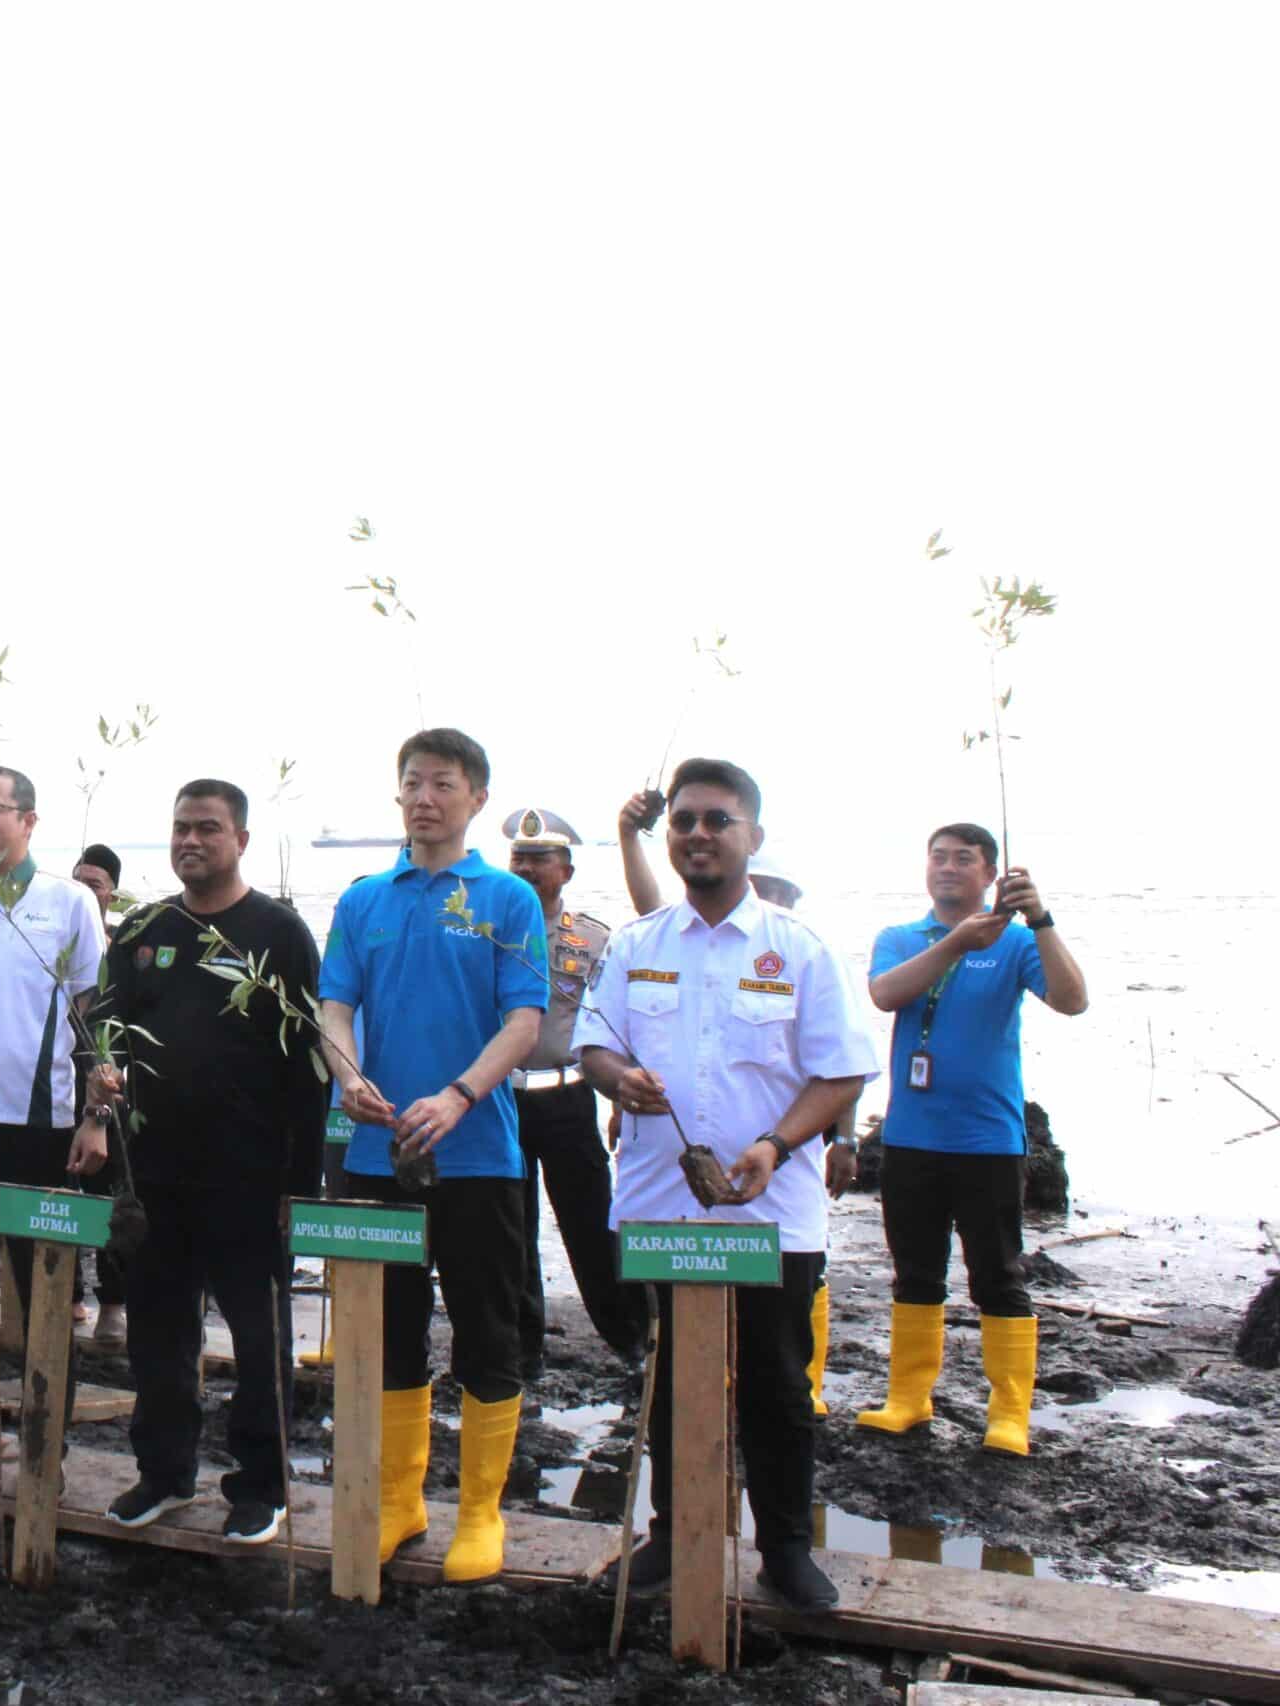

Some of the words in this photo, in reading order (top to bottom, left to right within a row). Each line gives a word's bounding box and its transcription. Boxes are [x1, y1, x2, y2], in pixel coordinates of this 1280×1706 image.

[40, 1200, 70, 1217] DLH
[29, 1215, 79, 1235] DUMAI
[293, 1223, 331, 1238] APICAL
[333, 1225, 357, 1240] KAO
[359, 1226, 422, 1245] CHEMICALS
[627, 1235, 697, 1251] KARANG
[702, 1236, 773, 1253] TARUNA
[672, 1255, 728, 1271] DUMAI
